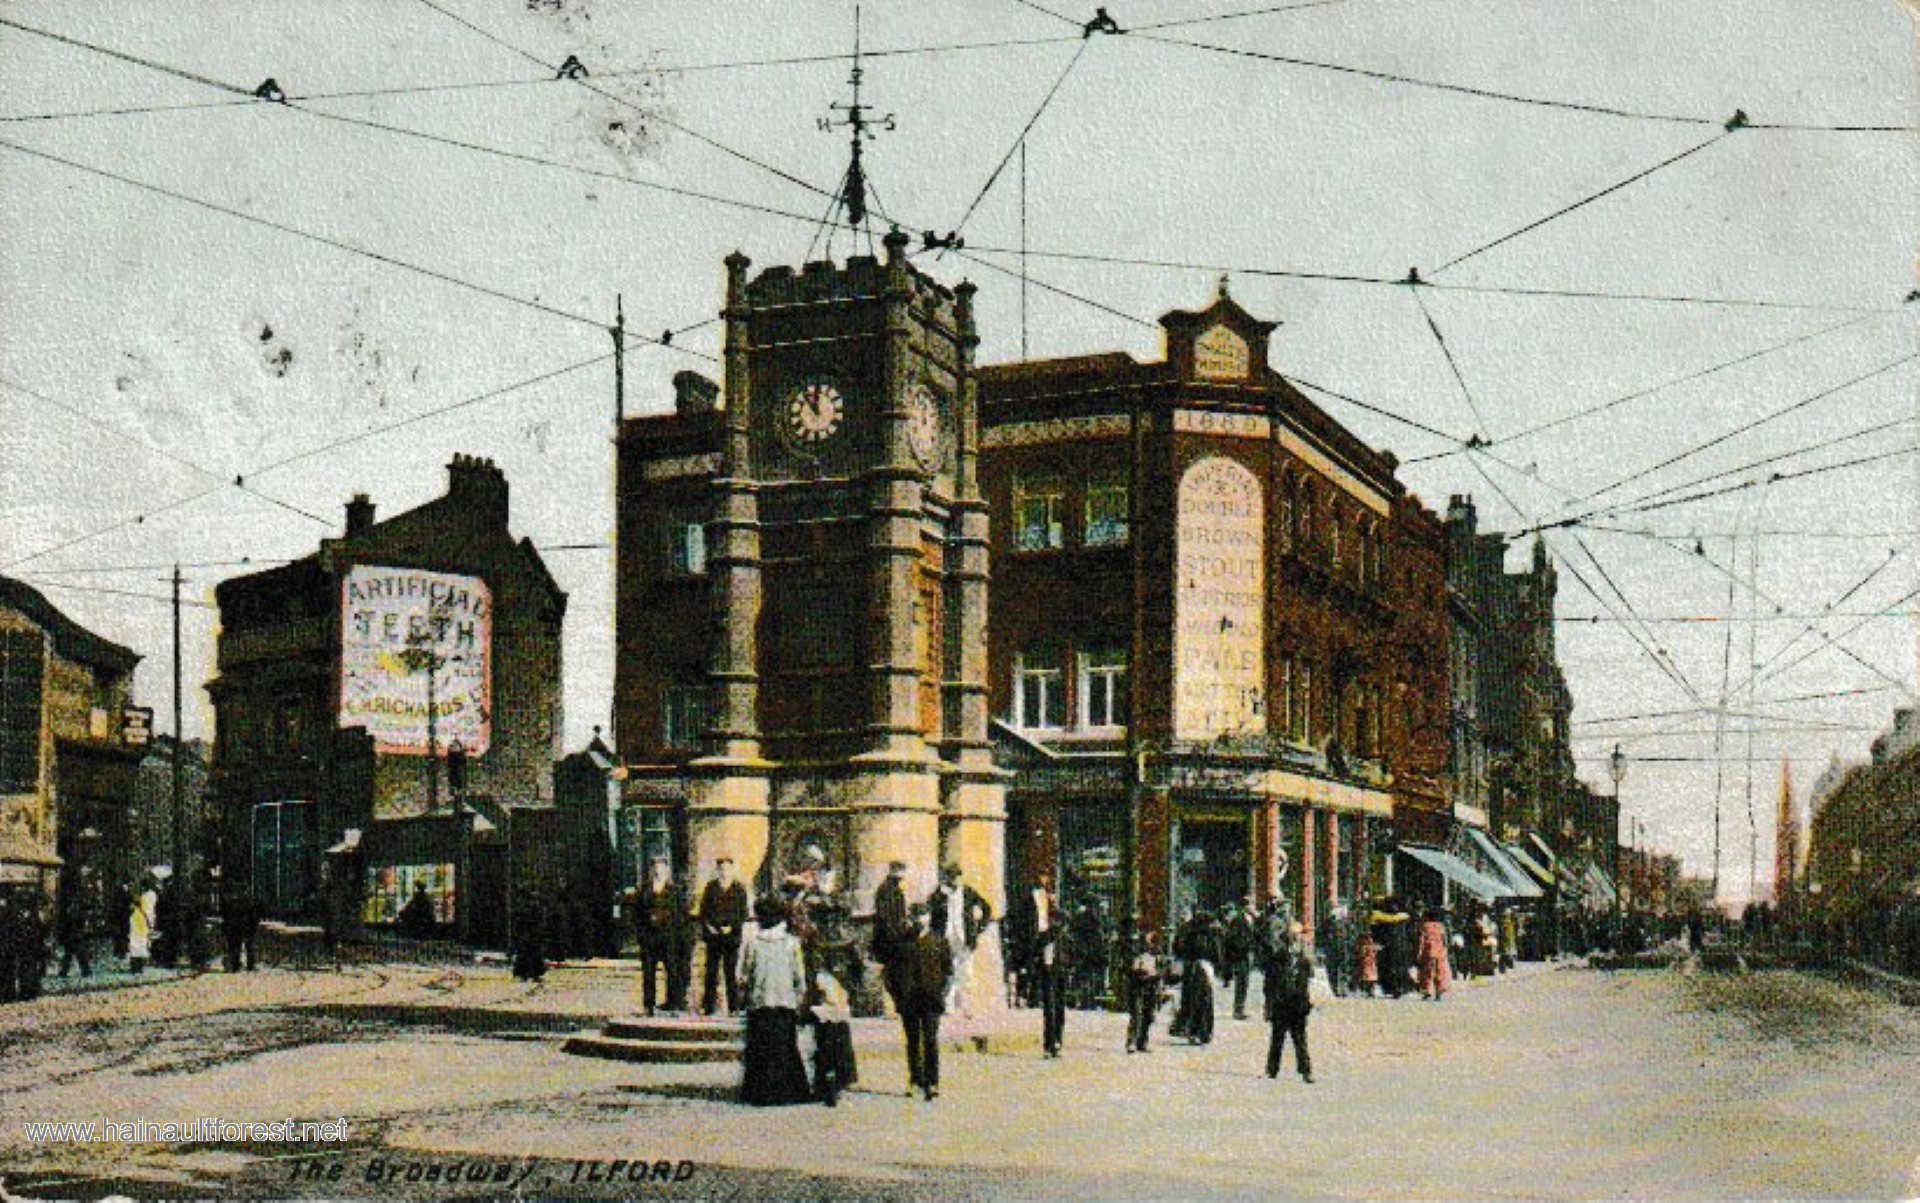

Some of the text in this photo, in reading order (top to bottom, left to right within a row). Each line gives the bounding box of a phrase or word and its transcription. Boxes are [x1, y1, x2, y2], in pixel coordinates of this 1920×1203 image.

[1185, 556, 1259, 580] STOUT
[349, 575, 487, 617] ARTIFICIAL
[355, 608, 475, 647] TEETH
